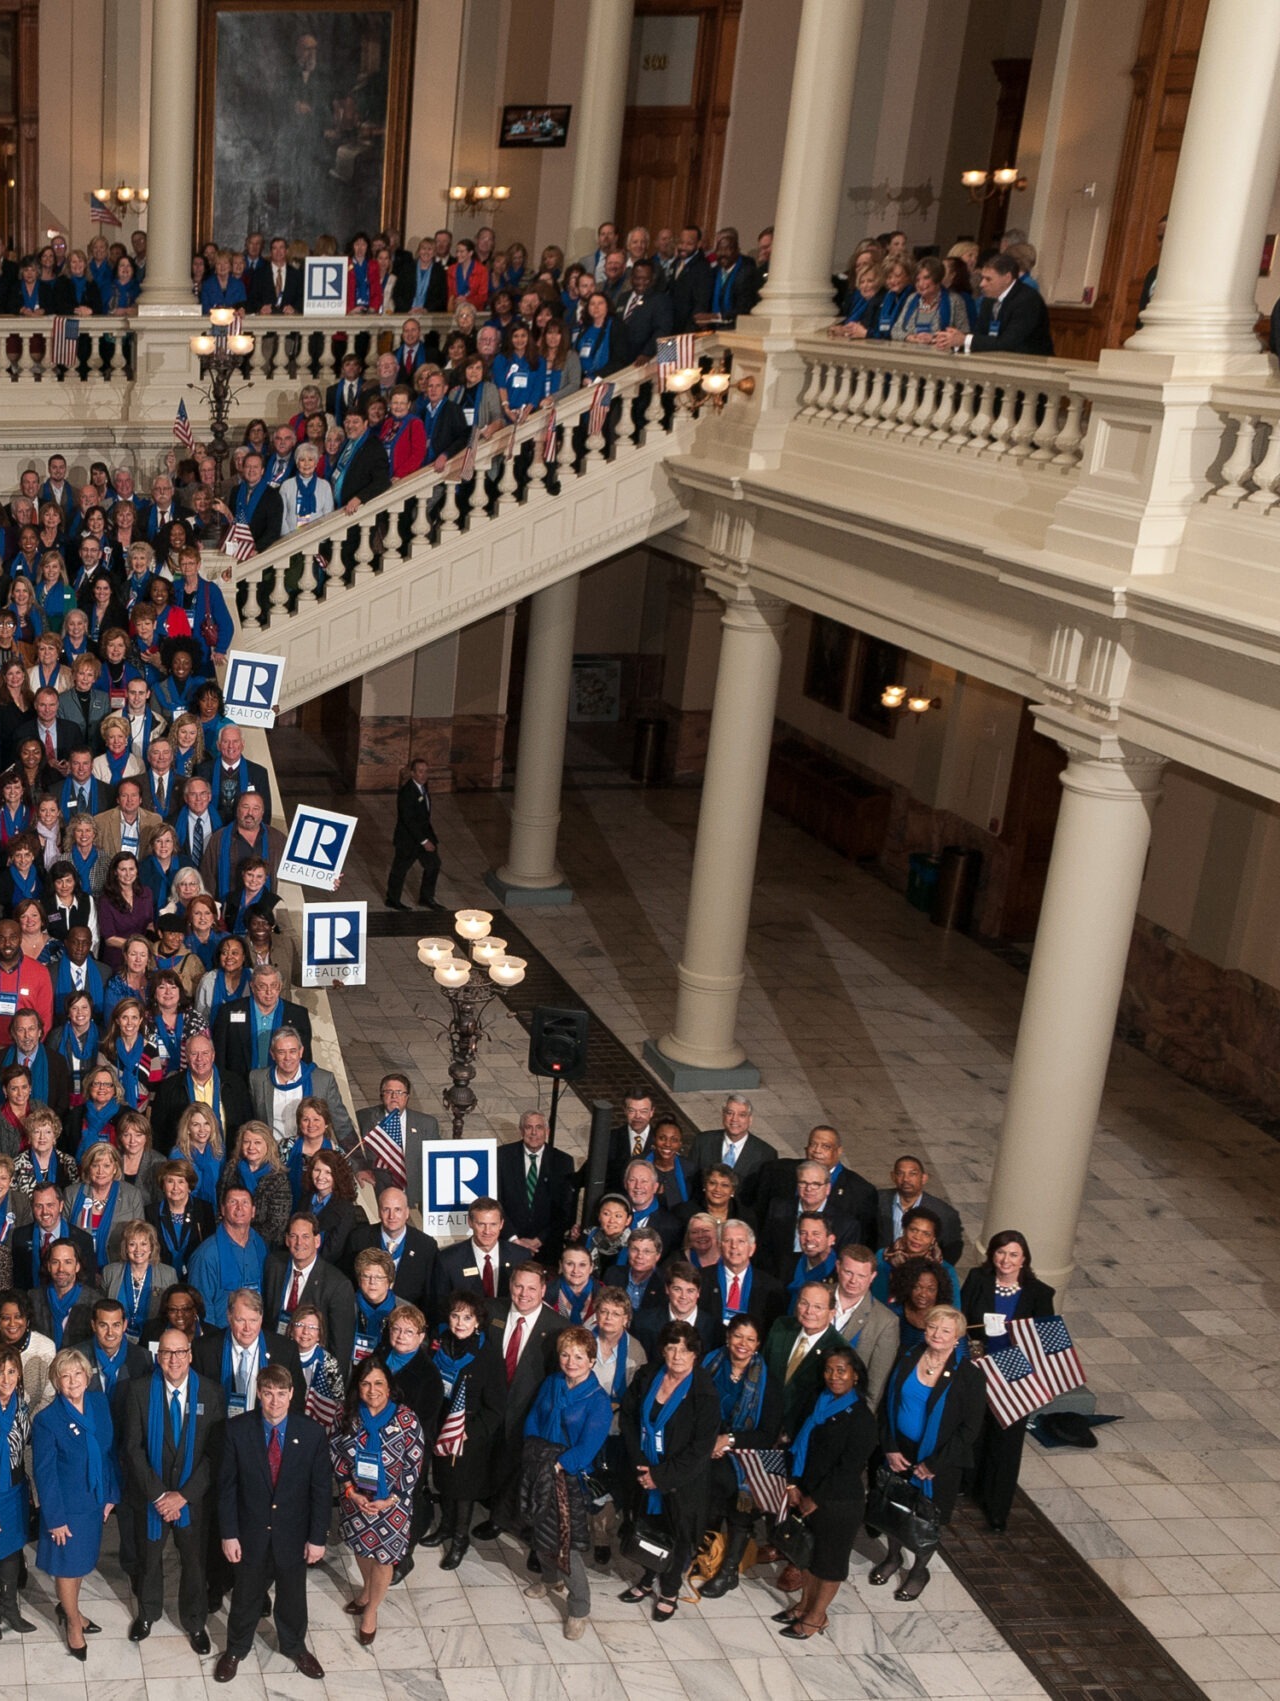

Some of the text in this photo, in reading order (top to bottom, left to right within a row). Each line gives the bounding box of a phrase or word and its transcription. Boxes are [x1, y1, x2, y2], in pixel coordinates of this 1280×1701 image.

[306, 301, 343, 309] REALTOR
[282, 863, 333, 881] REALTOR
[306, 966, 359, 977] REALTOR
[428, 1215, 468, 1225] REALT
